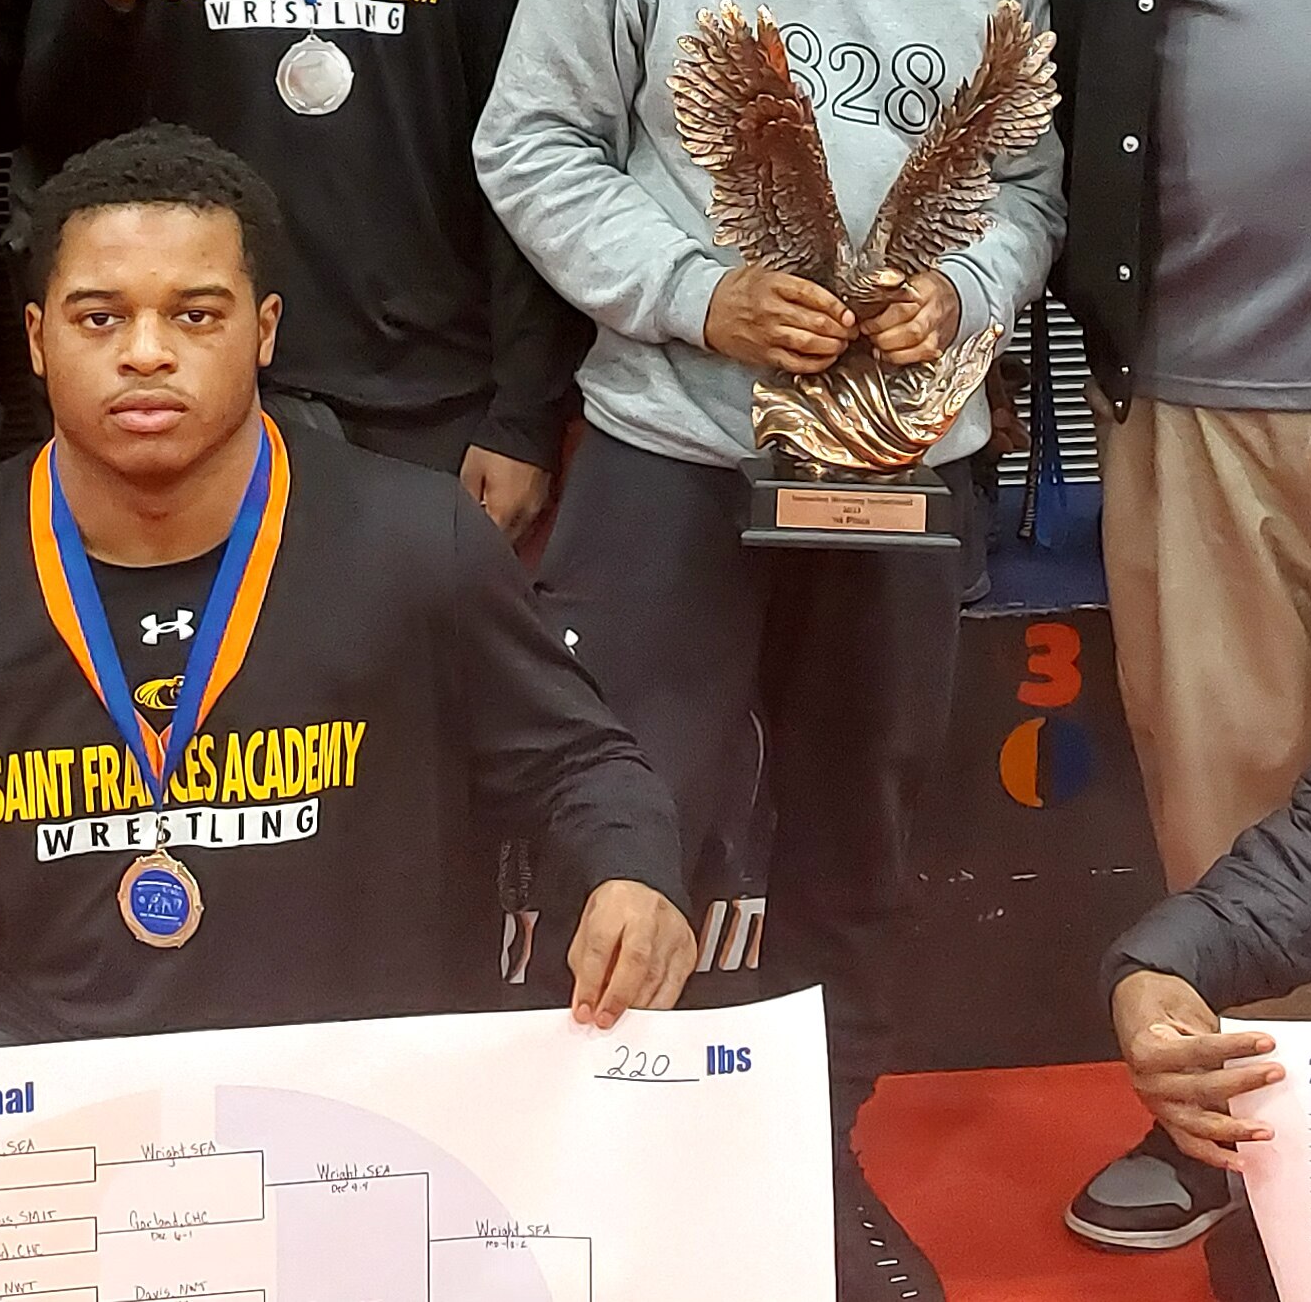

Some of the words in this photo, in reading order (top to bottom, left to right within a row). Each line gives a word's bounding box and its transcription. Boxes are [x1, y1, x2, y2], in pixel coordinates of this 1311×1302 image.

[1017, 622, 1083, 708] 3
[84, 733, 219, 813] FRACES
[221, 720, 368, 803] ACADEMY
[42, 803, 316, 857] WRESTLING
[606, 1045, 670, 1078] 220
[706, 1044, 752, 1076] lbs
